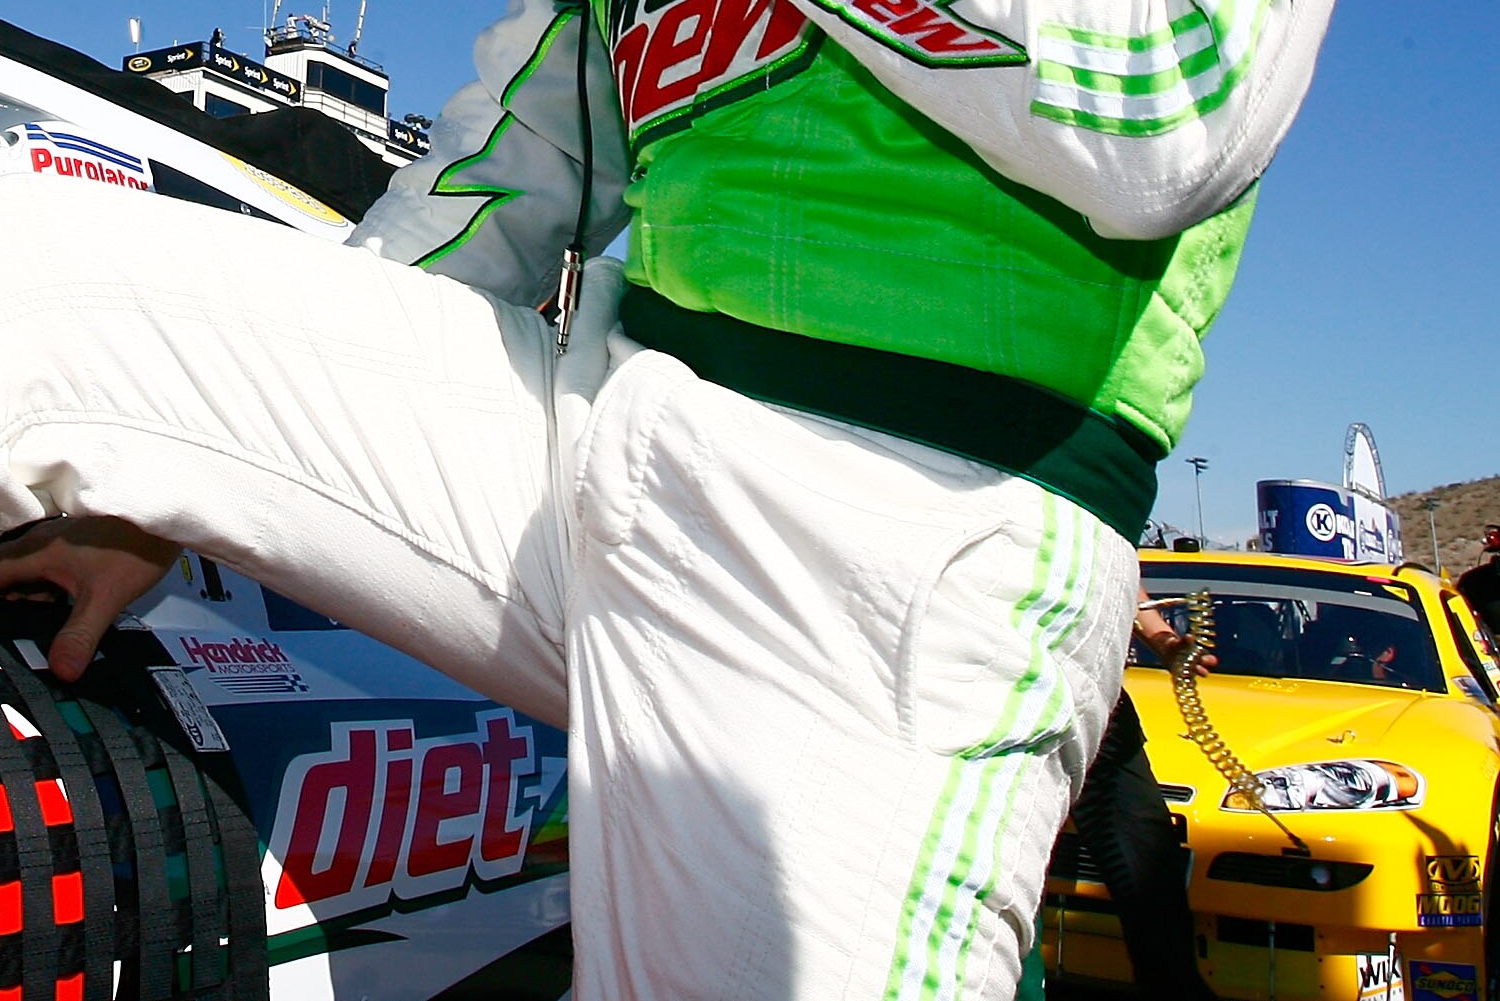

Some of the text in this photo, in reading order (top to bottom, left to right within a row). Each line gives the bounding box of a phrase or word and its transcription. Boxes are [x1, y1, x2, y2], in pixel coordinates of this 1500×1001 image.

[167, 53, 187, 64] Sprint
[214, 53, 233, 69] Sprint
[244, 66, 261, 81] Sprint
[273, 77, 290, 92] Sprint
[31, 148, 148, 191] Purolator
[179, 636, 289, 673] Hendrick
[218, 663, 296, 675] MOTORSPORTS
[273, 715, 529, 912] diet
